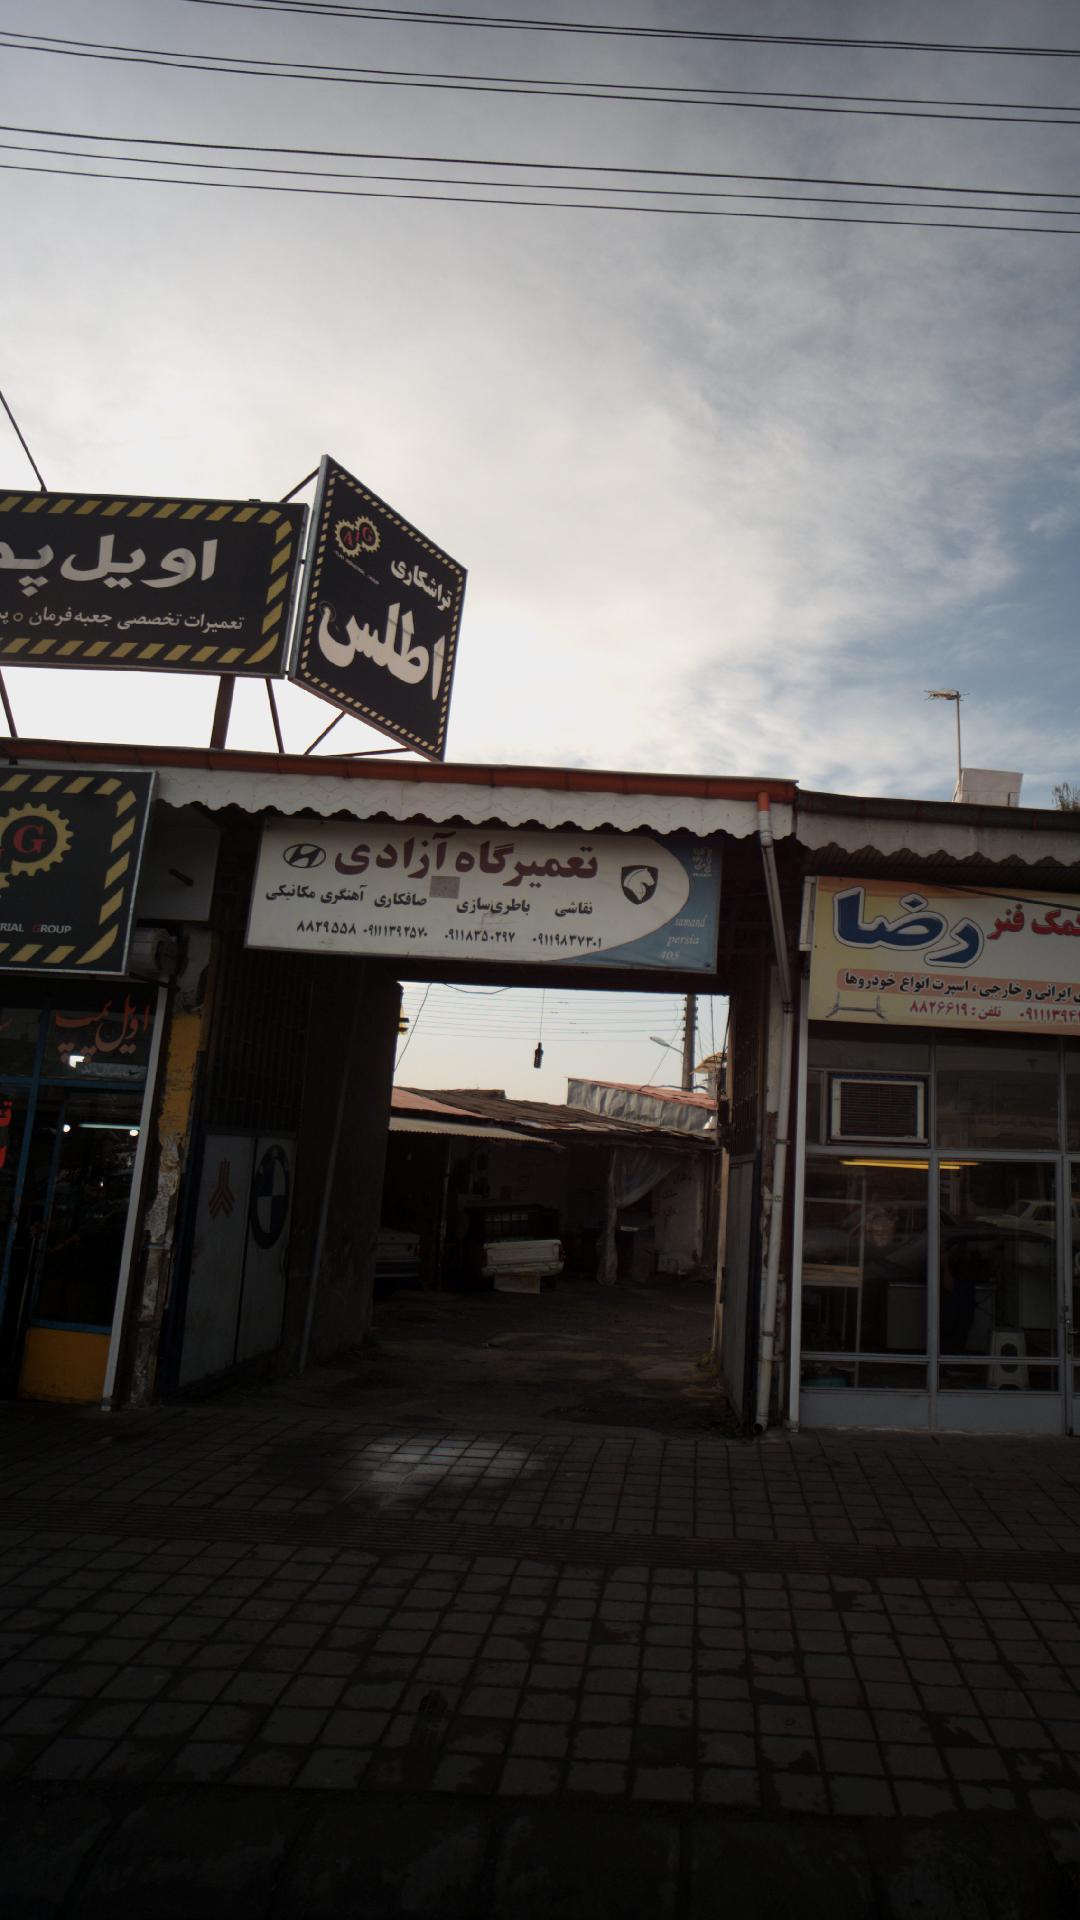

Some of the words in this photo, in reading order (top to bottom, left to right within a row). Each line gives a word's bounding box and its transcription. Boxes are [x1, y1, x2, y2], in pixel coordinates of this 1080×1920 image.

[60, 533, 218, 590] اویل
[391, 559, 452, 611] تراشکاری
[117, 611, 182, 630] تخصصی
[184, 613, 245, 633] تعمیرات
[318, 602, 446, 701] اطلس
[334, 831, 456, 880] آزادی
[455, 840, 598, 887] تعمیرگاه
[265, 884, 316, 901] مکانیکی
[320, 884, 367, 904] آهنگری
[374, 892, 427, 908] صافکاری
[555, 902, 593, 917] نقاشی
[0, 922, 25, 933] RIAL
[835, 889, 982, 966] رضا
[986, 903, 1025, 940] فنر
[845, 972, 896, 991] خودروها
[900, 976, 930, 993] انواع
[932, 980, 969, 995] اسپرت
[1025, 989, 1032, 999] و
[1035, 985, 1072, 1001] ایرانی
